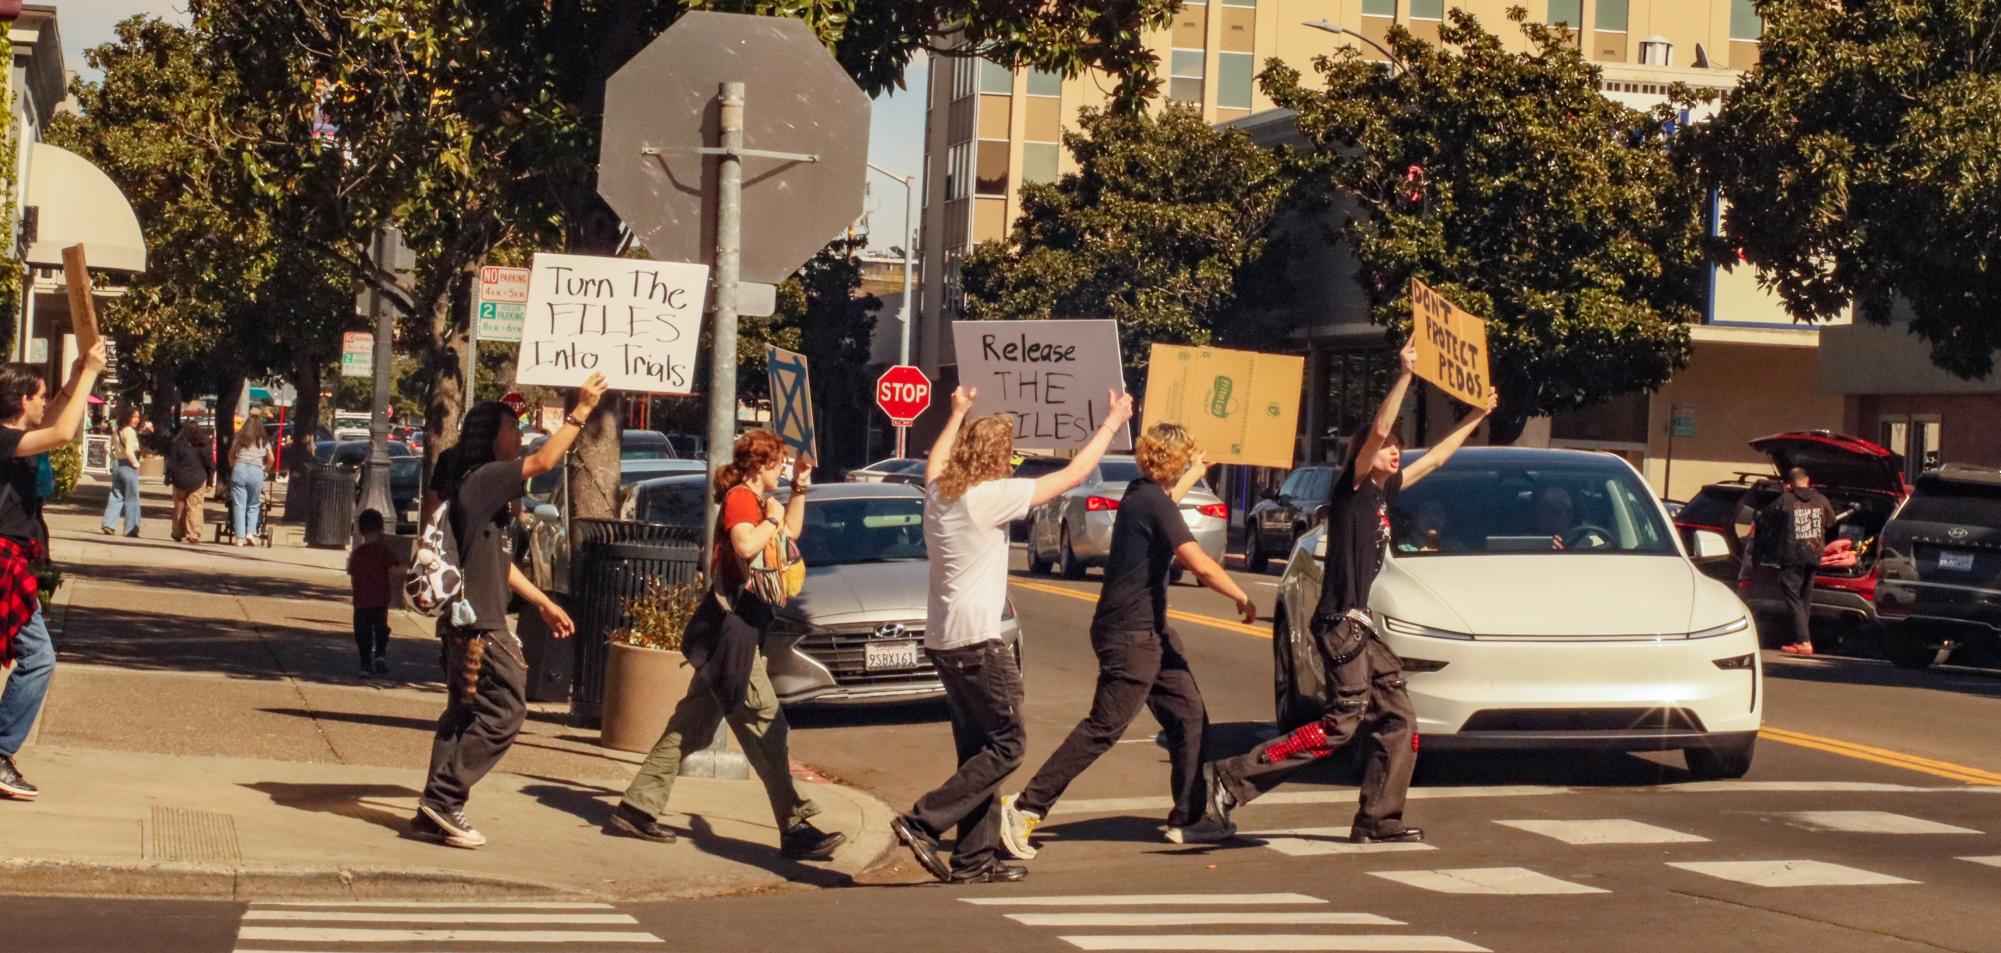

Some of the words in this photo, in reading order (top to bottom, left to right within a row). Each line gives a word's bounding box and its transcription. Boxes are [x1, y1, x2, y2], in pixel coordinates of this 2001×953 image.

[484, 268, 498, 282] NO
[500, 273, 527, 284] PARKING
[546, 266, 614, 298] Turn
[628, 270, 687, 309] The
[483, 303, 493, 318] 2
[498, 311, 525, 321] PARKING
[547, 302, 681, 343] FILES
[982, 333, 1076, 363] Release
[1426, 315, 1478, 370] PROTECT
[526, 340, 599, 372] Into
[613, 343, 686, 387] Trials
[1439, 351, 1482, 399] PEDOS
[880, 381, 928, 403] STOP
[993, 370, 1074, 404] THE
[869, 652, 913, 667] 9SBX161
